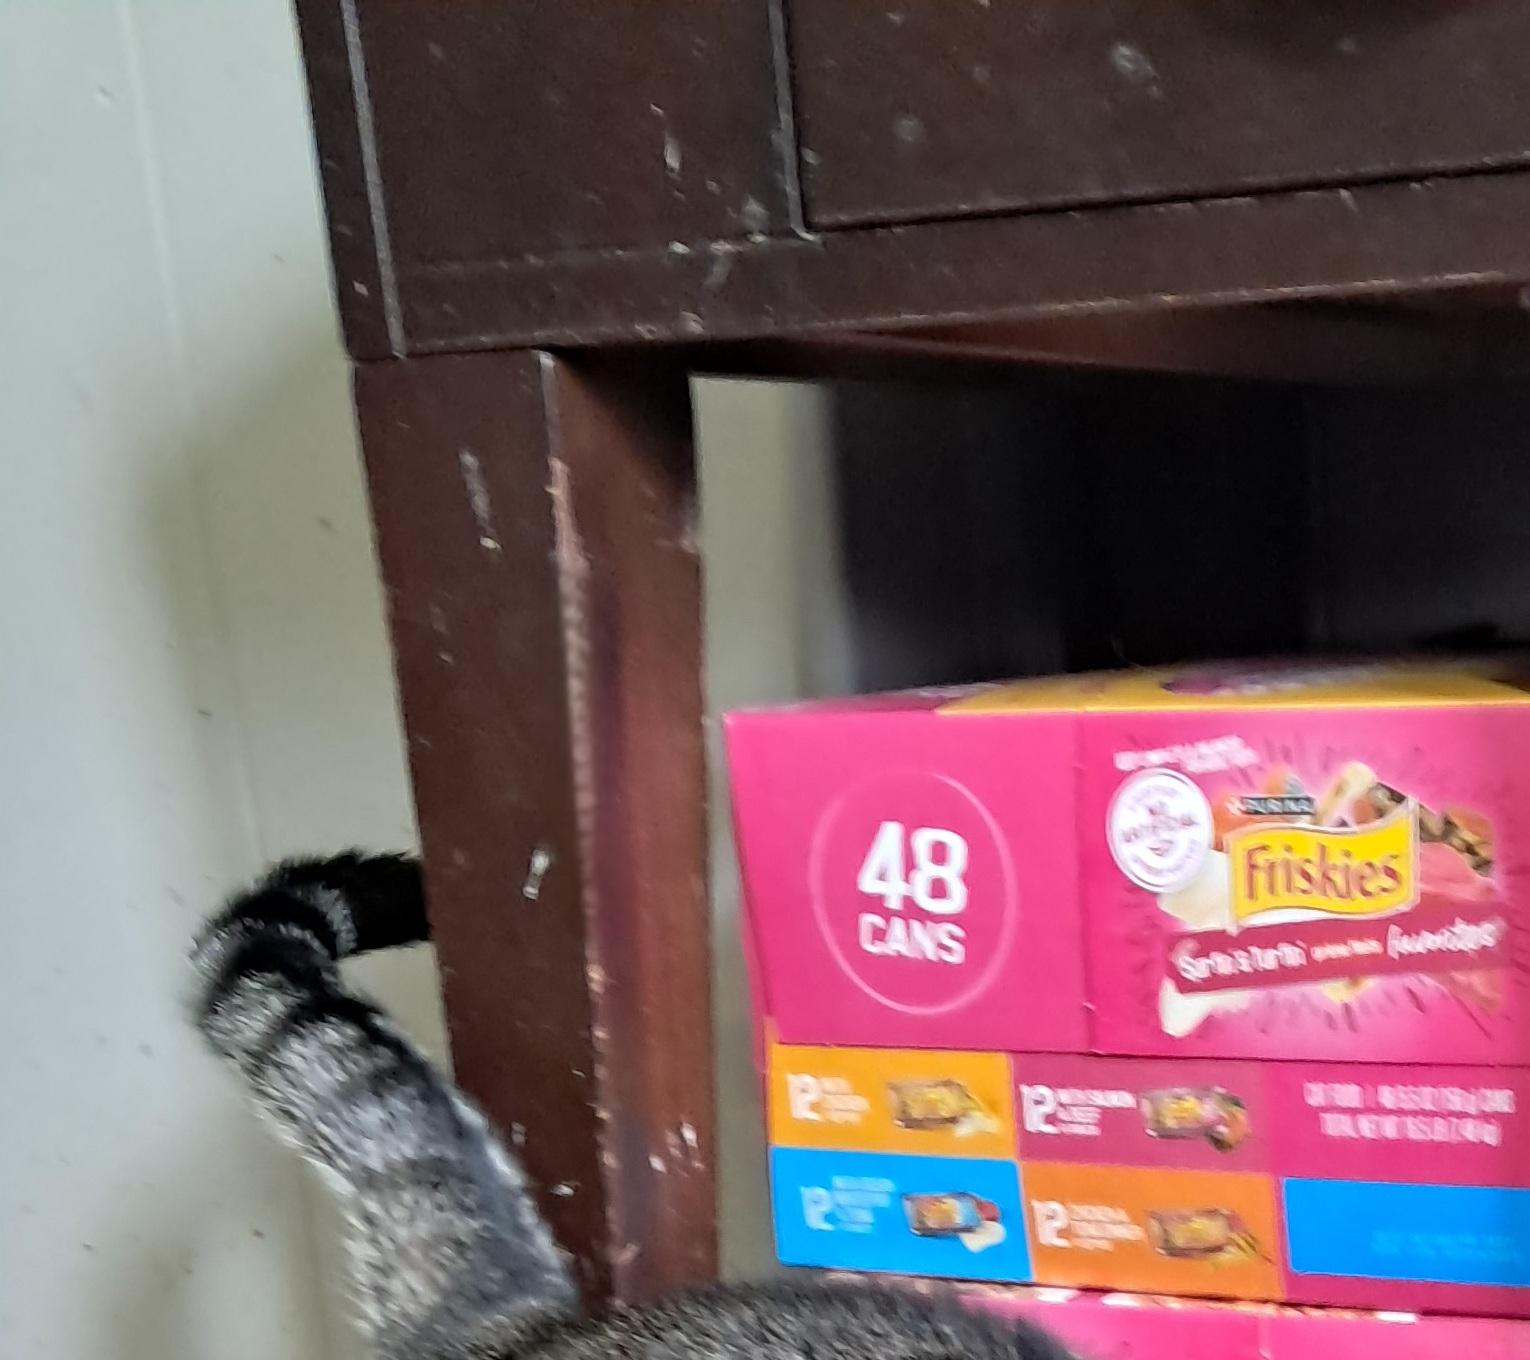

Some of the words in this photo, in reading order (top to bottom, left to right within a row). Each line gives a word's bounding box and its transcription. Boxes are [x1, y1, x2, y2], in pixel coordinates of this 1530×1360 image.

[857, 820, 968, 915] 48
[1246, 841, 1401, 901] Friskies
[858, 912, 967, 965] CANS
